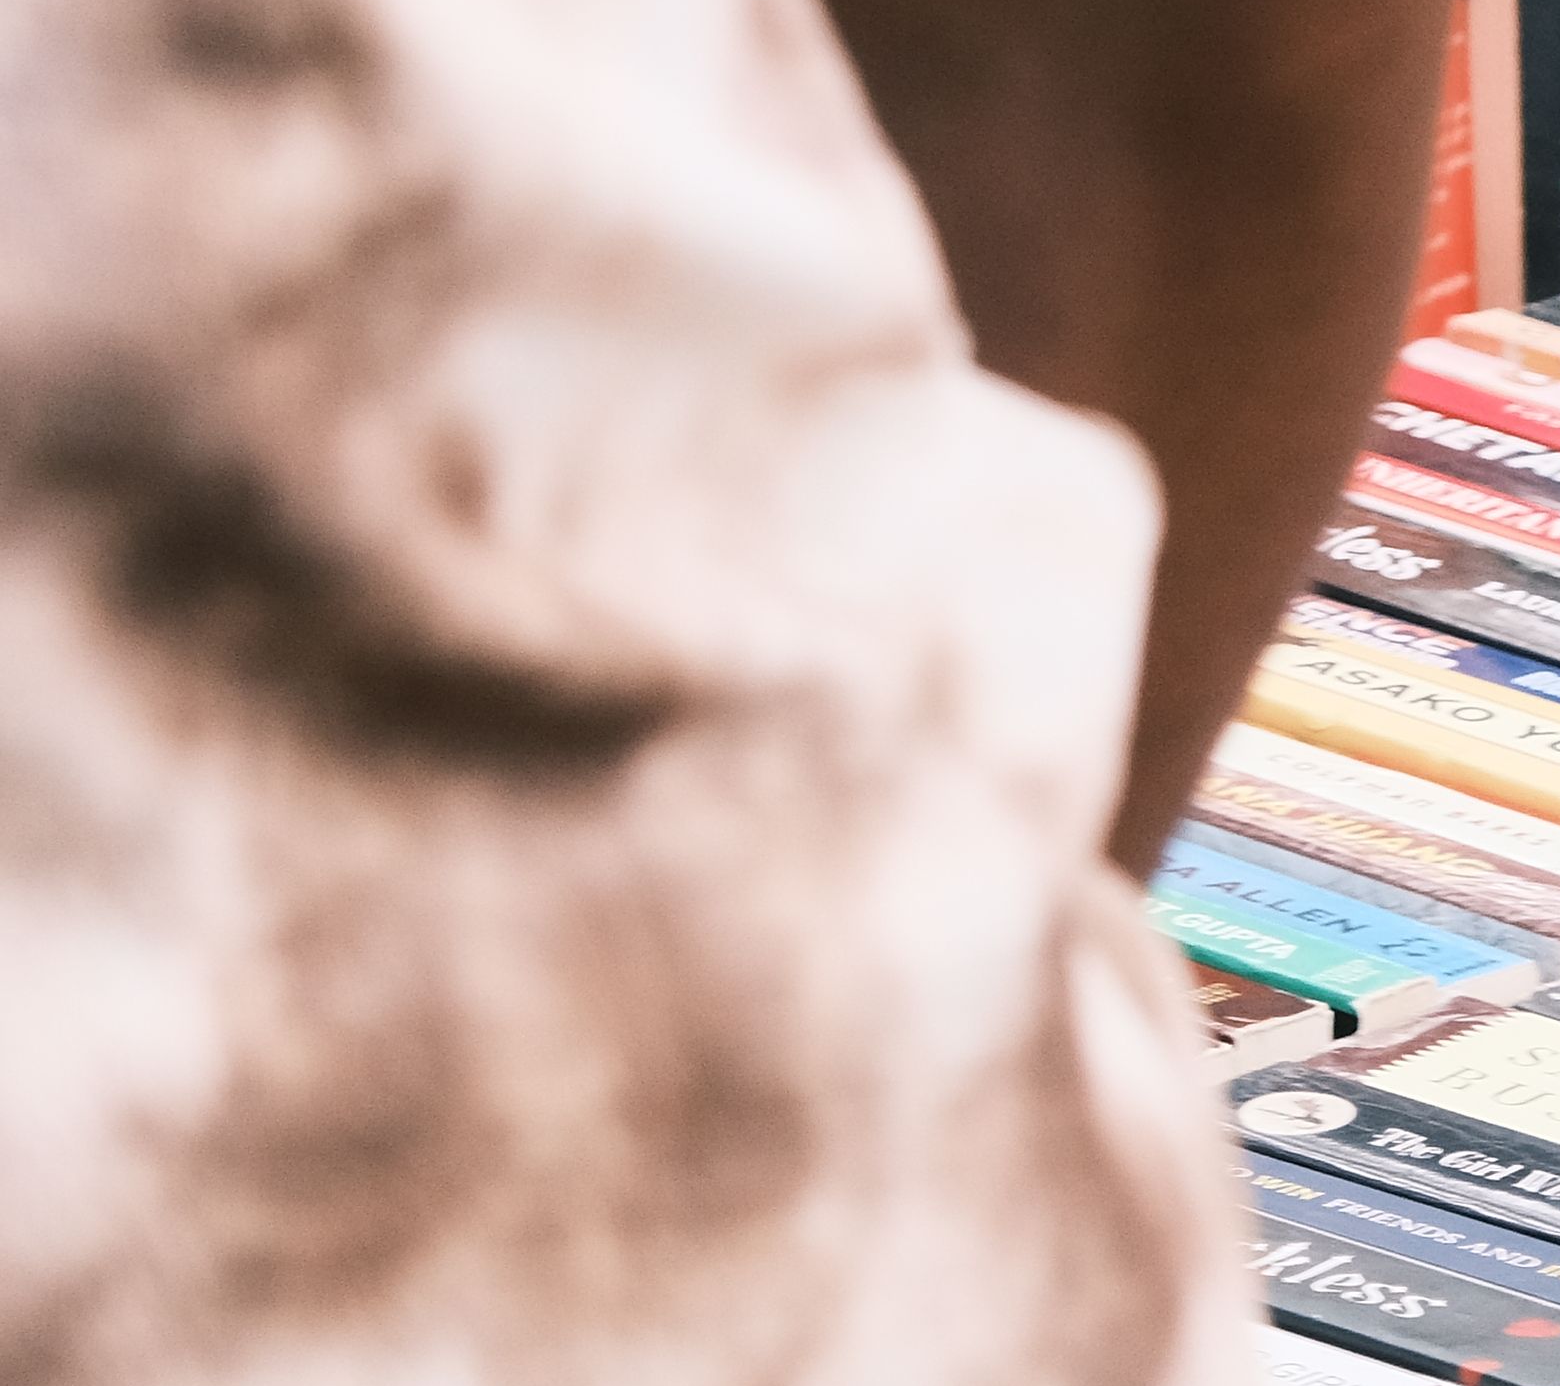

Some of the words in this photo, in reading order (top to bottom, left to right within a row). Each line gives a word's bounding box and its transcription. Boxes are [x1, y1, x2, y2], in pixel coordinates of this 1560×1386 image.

[1296, 655, 1497, 724] ASAKO
[1368, 1126, 1445, 1164] The
[1437, 1145, 1510, 1182] Girl
[1251, 1174, 1327, 1202] WIN
[1322, 1197, 1467, 1248] FRIENDS
[1455, 1240, 1544, 1272] AND
